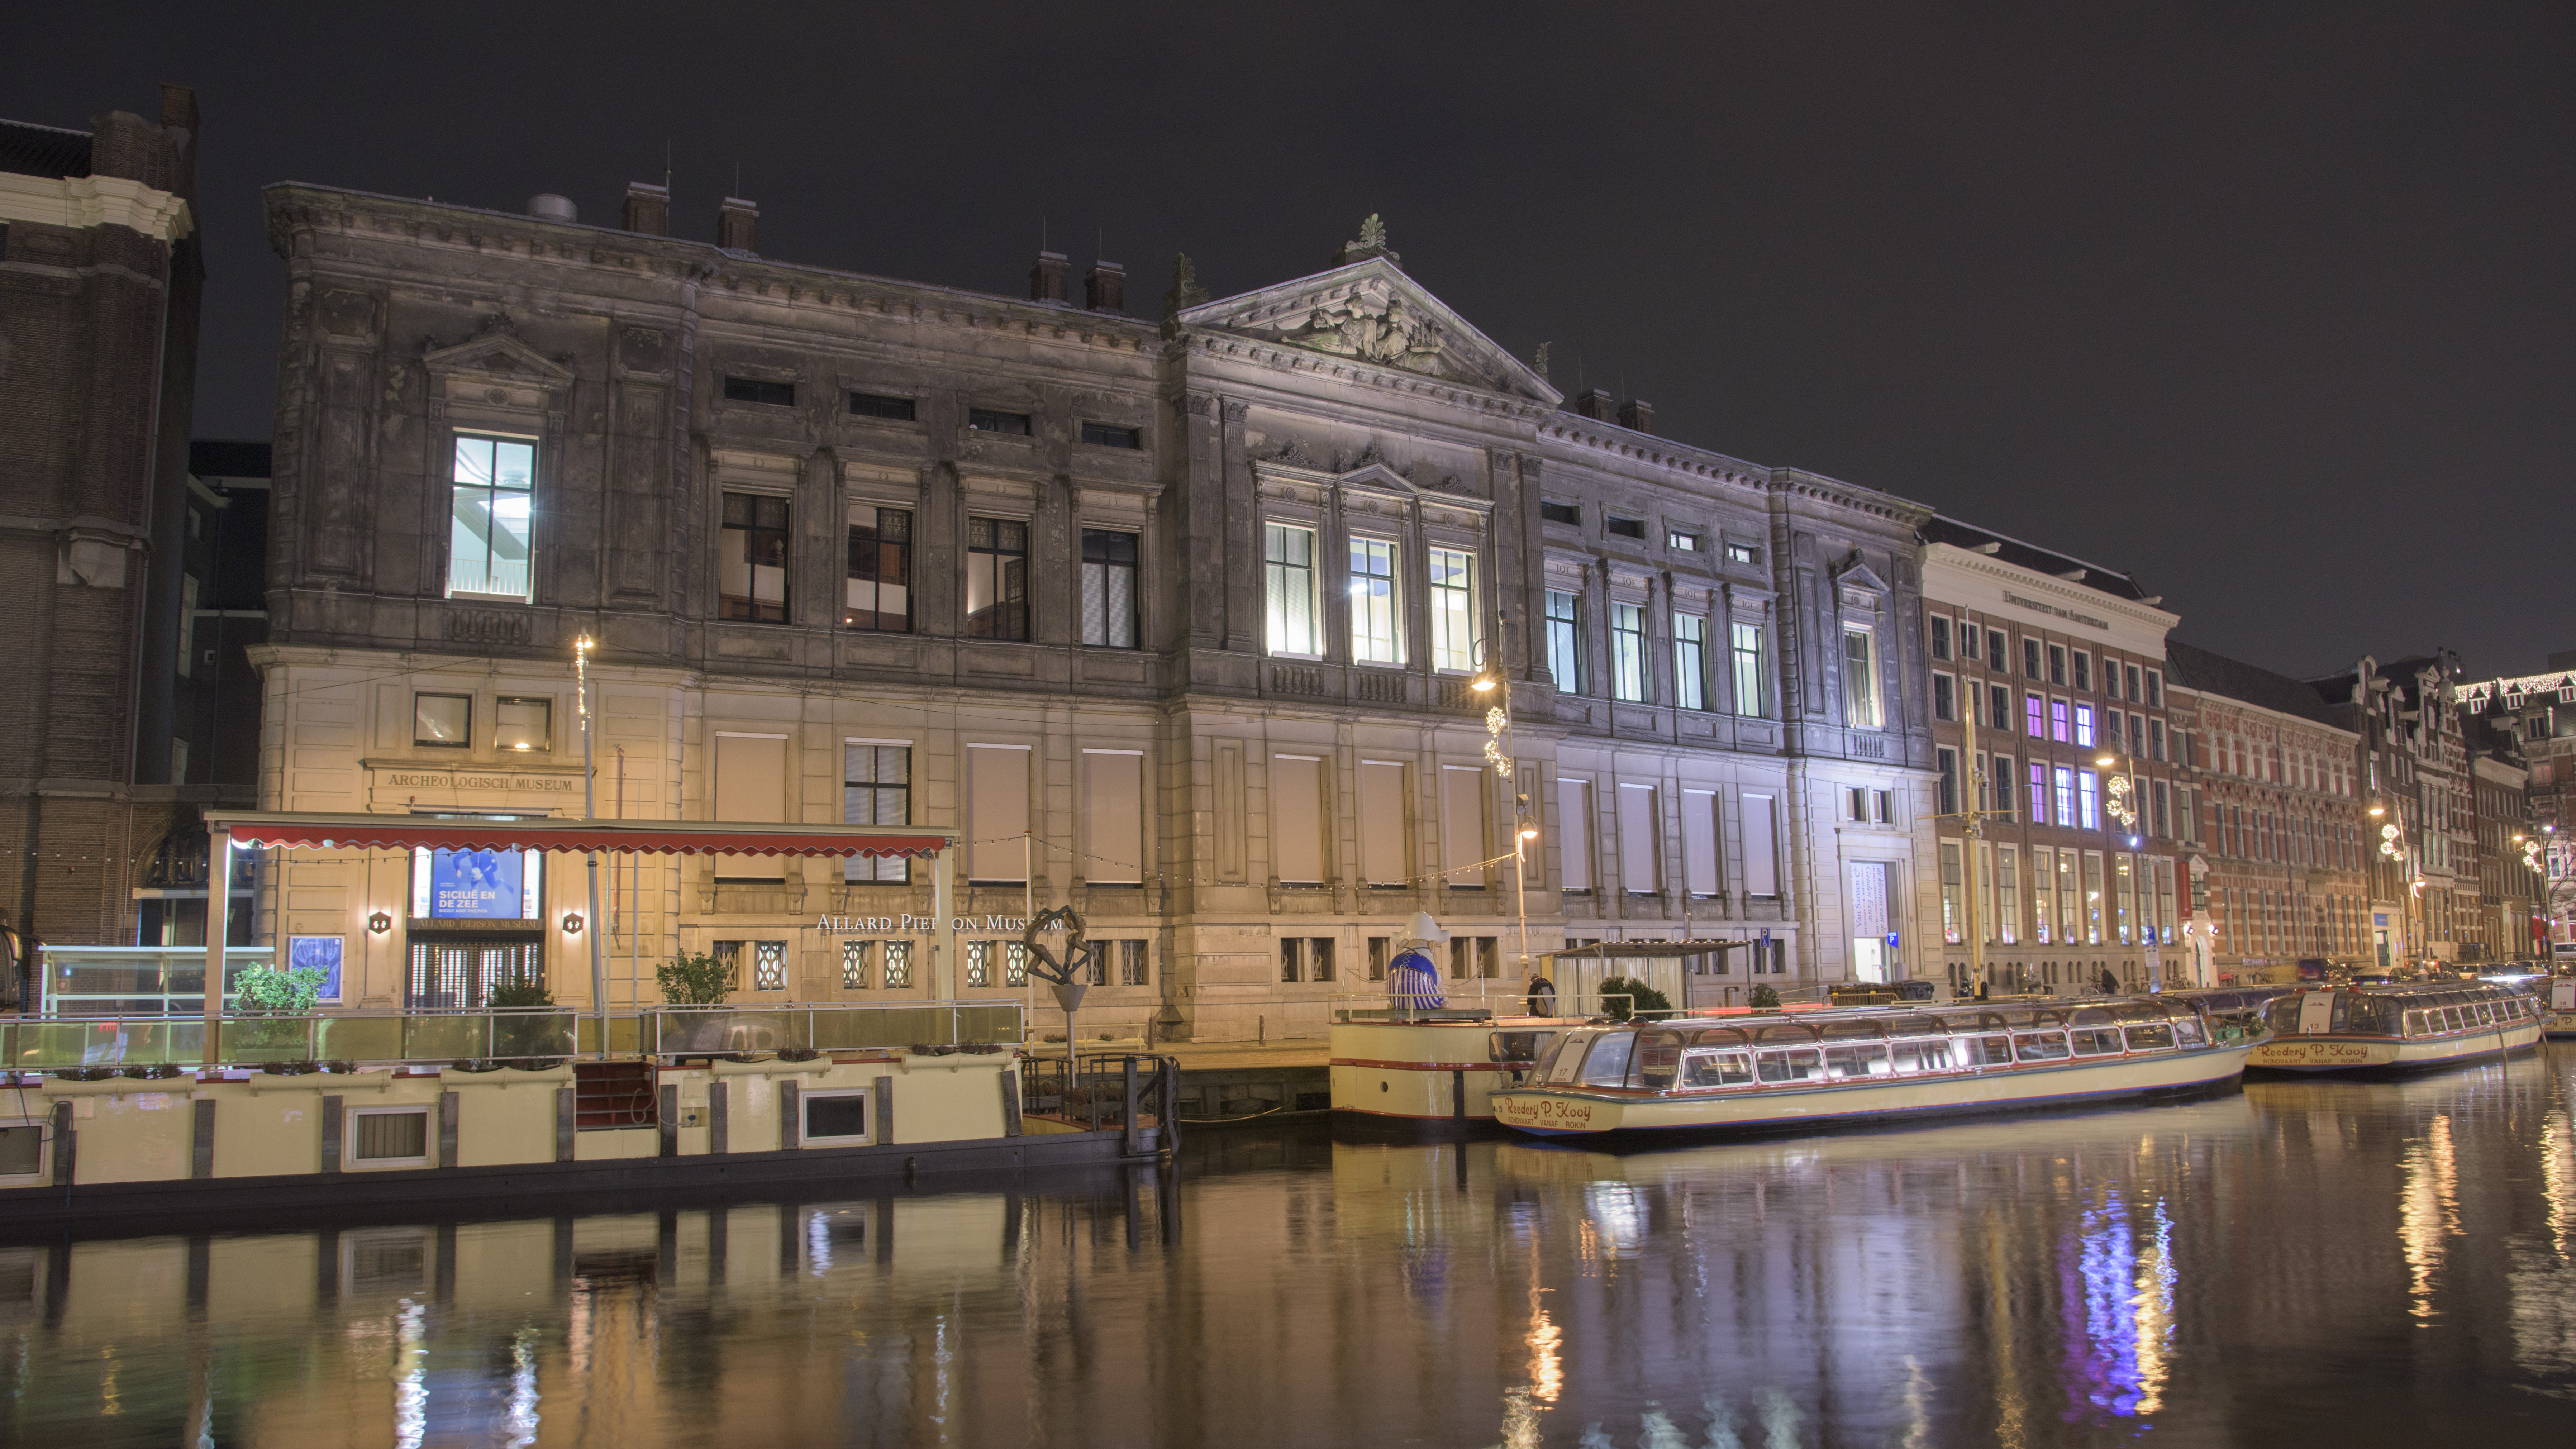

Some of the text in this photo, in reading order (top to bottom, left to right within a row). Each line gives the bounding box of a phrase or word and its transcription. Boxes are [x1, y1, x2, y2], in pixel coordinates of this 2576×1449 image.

[388, 774, 572, 791] ARCHEOLOGISCH MUSEUM
[439, 889, 495, 899] SICILIË EN
[1762, 929, 1767, 939] P
[1508, 1117, 1533, 1125] RONDVAART
